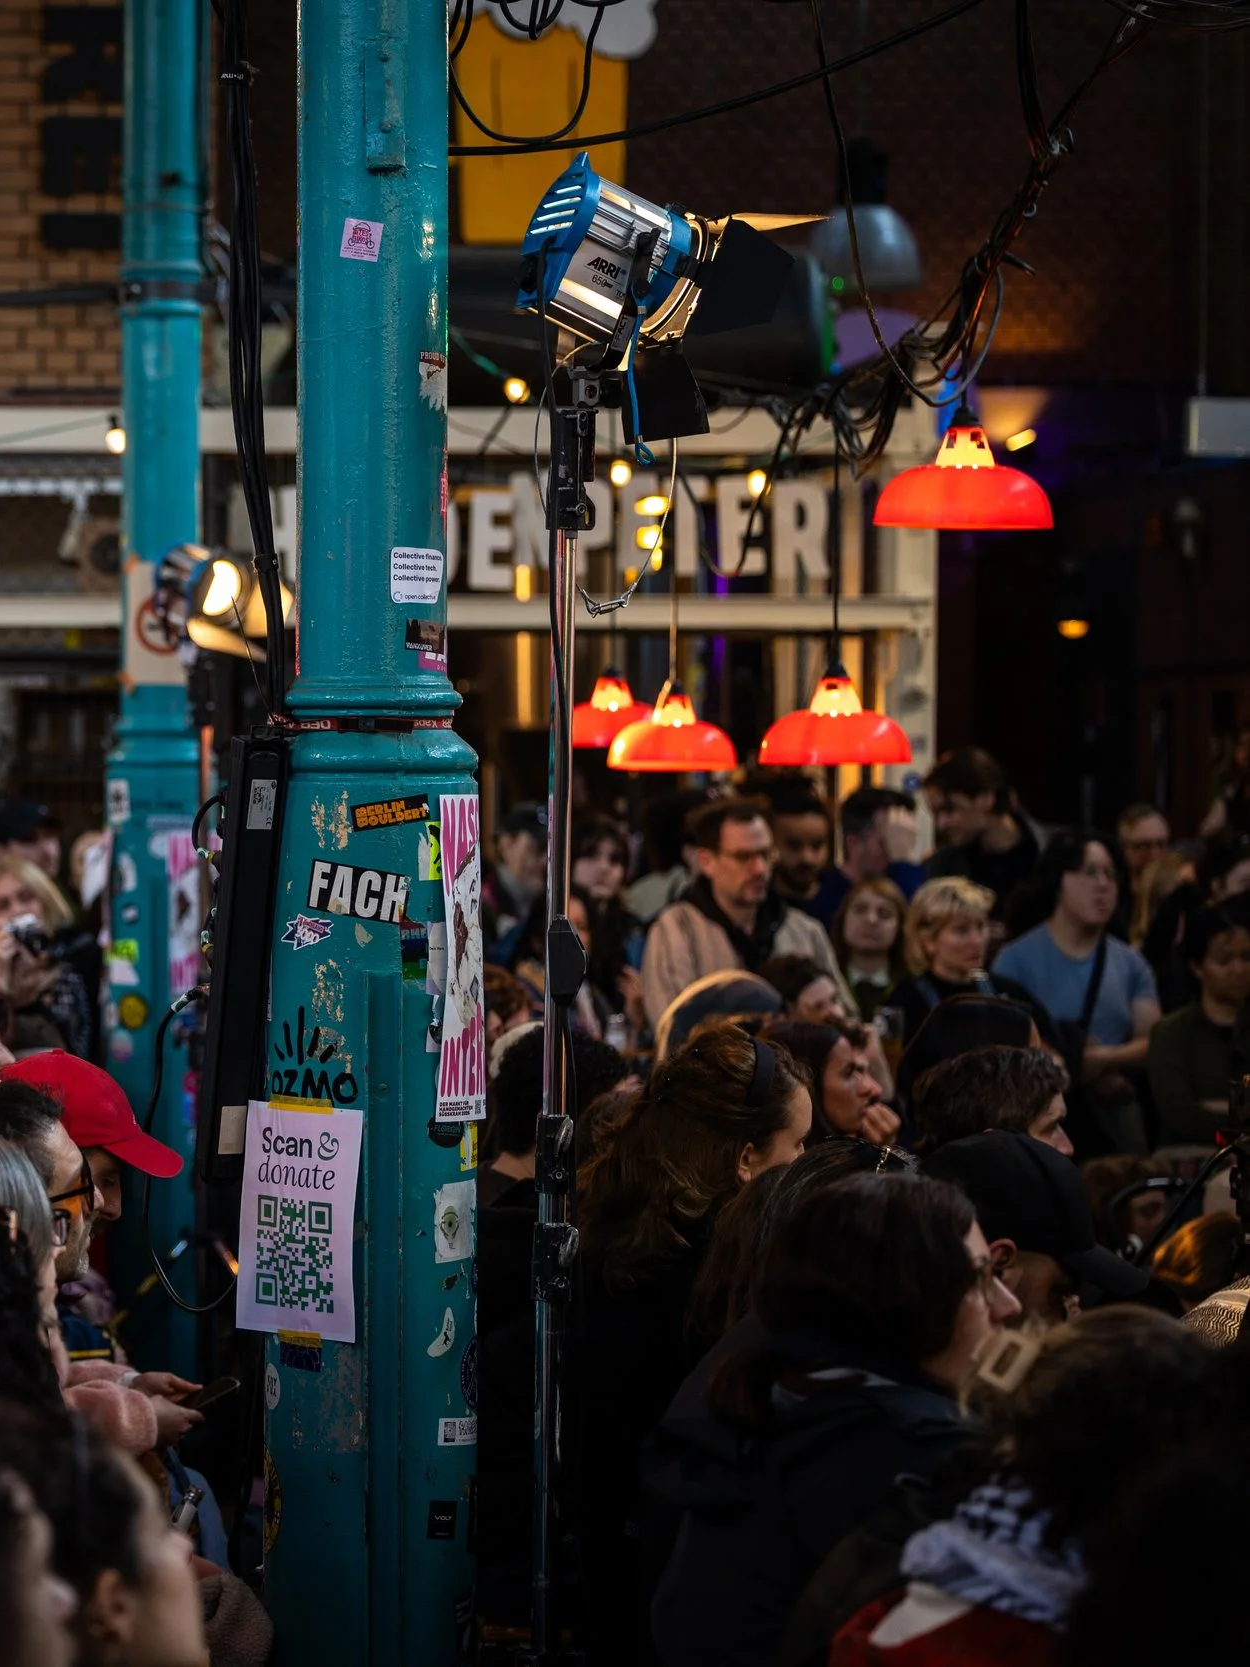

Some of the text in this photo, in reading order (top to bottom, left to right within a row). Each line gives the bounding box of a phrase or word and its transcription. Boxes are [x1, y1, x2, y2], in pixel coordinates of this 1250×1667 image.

[587, 256, 620, 279] ARRI
[420, 351, 440, 361] PROUD
[393, 552, 425, 560] Collective
[393, 563, 425, 571] Collective
[393, 574, 425, 582] Collective
[355, 800, 405, 818] BERLIN
[356, 807, 428, 828] BOULDERT
[308, 861, 409, 923] FACH
[272, 1068, 359, 1107] OZMO
[262, 1126, 340, 1161] Scan &
[257, 1155, 336, 1191] donate
